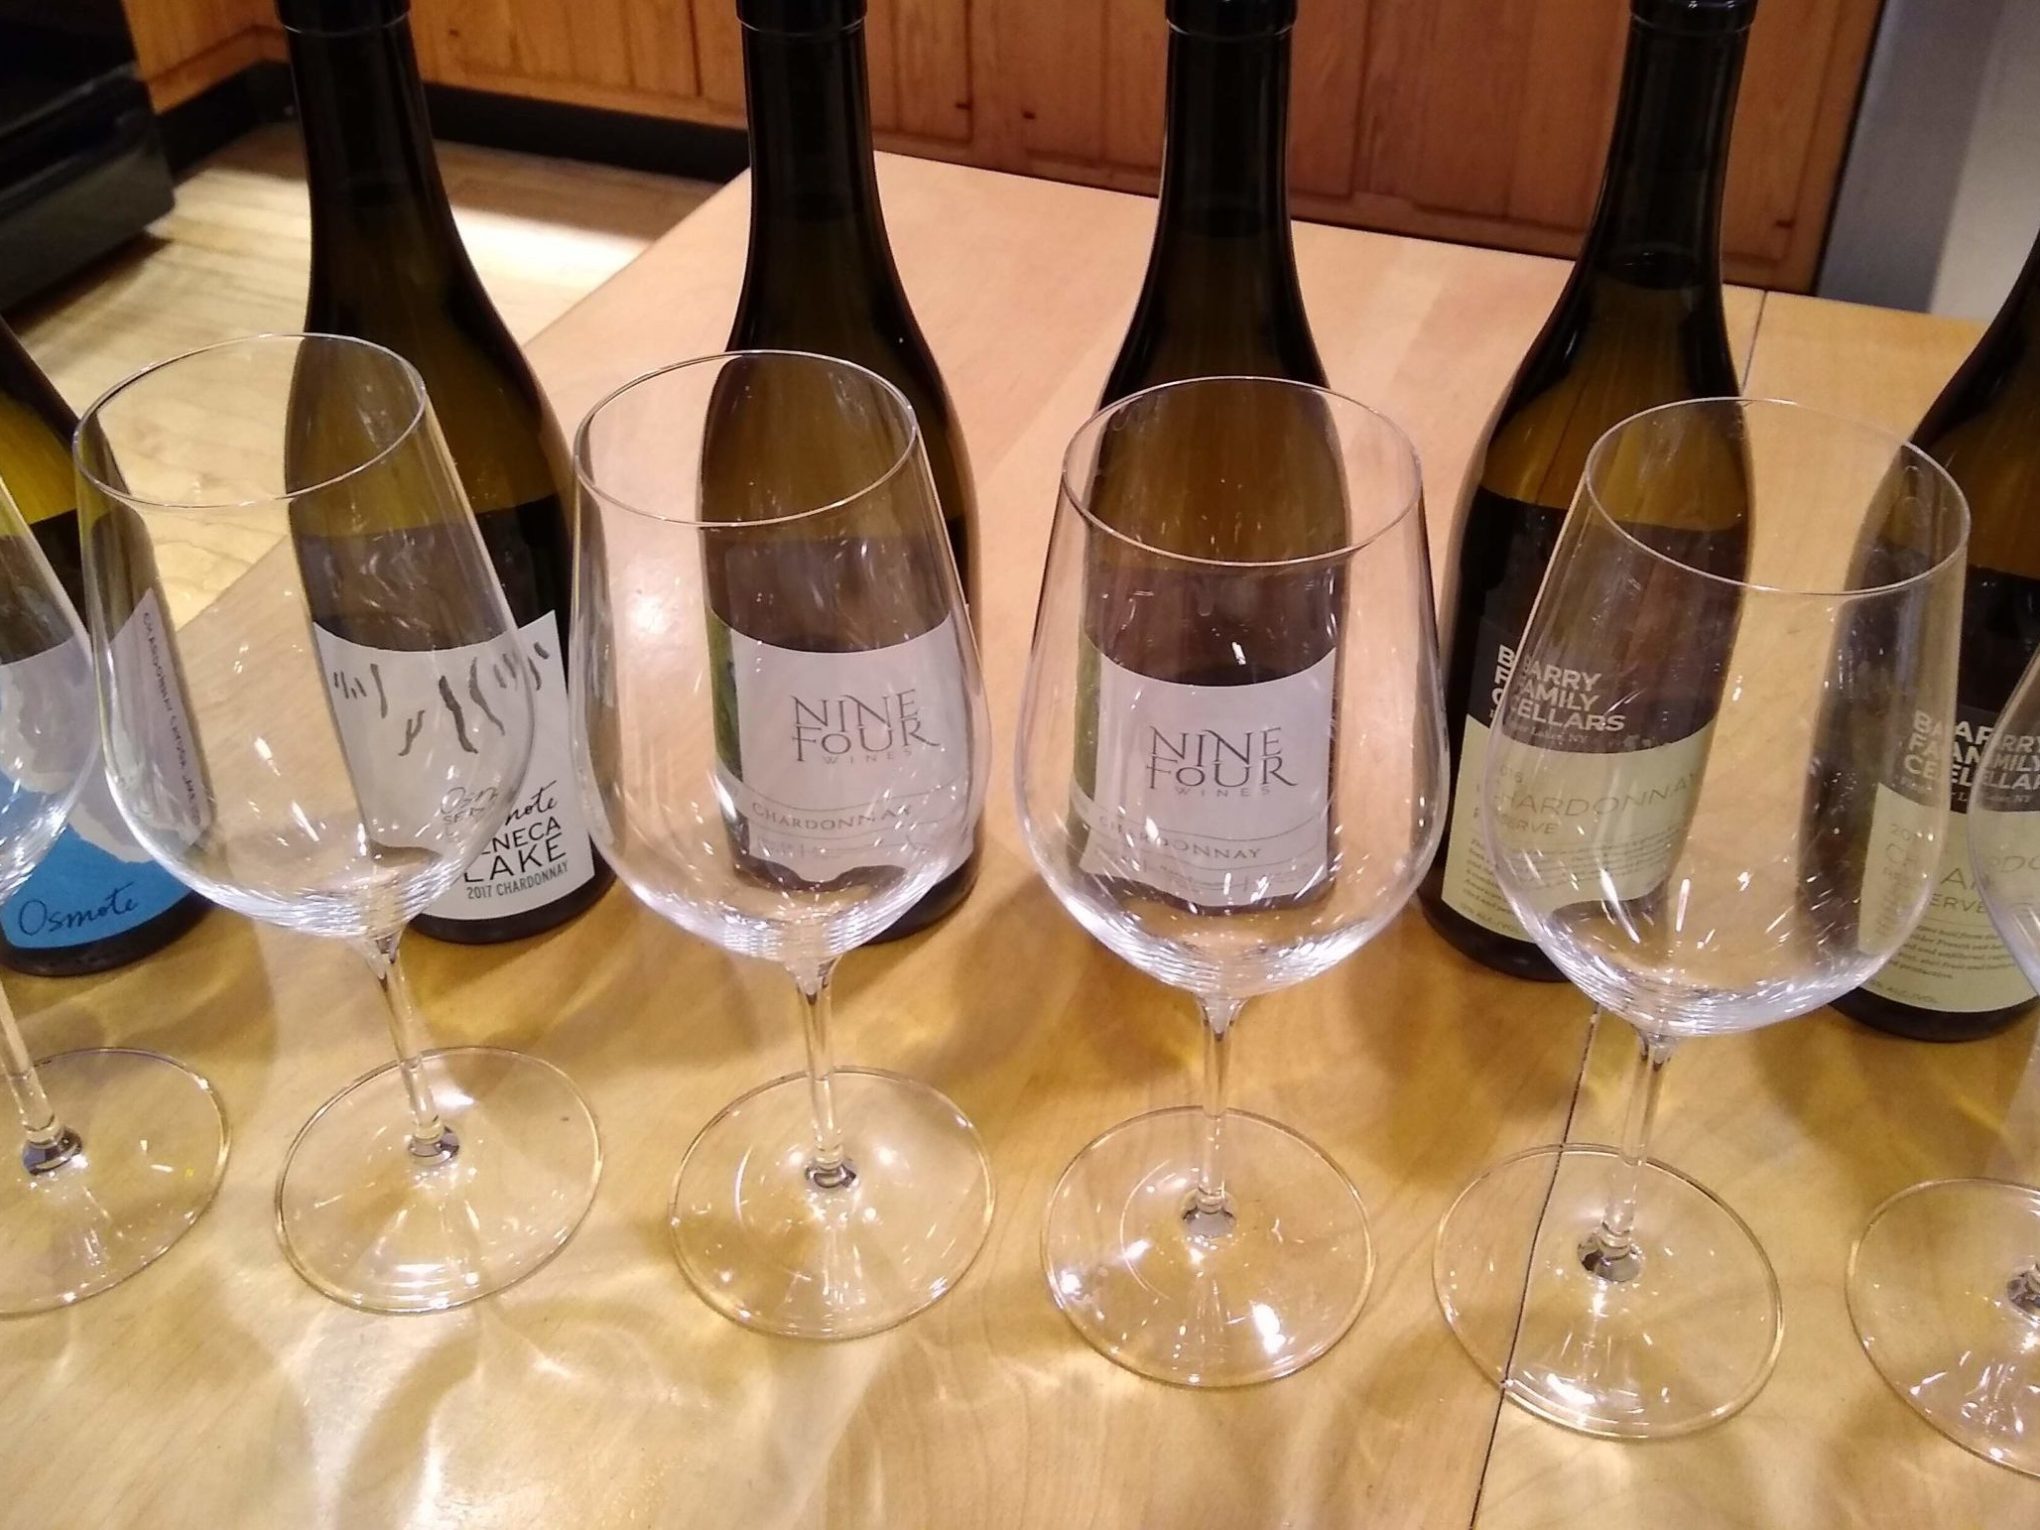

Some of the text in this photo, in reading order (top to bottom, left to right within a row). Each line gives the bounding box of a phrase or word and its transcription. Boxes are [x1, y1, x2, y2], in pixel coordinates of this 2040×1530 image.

[791, 689, 916, 732] NINE
[792, 717, 940, 762] FOUR
[823, 749, 913, 765] WINES
[1150, 725, 1282, 767] NINE
[1146, 755, 1298, 789] FOUR
[1176, 786, 1271, 798] WINES
[466, 861, 569, 900] 2017 CHARDONNAY
[19, 880, 138, 937] Osmote
